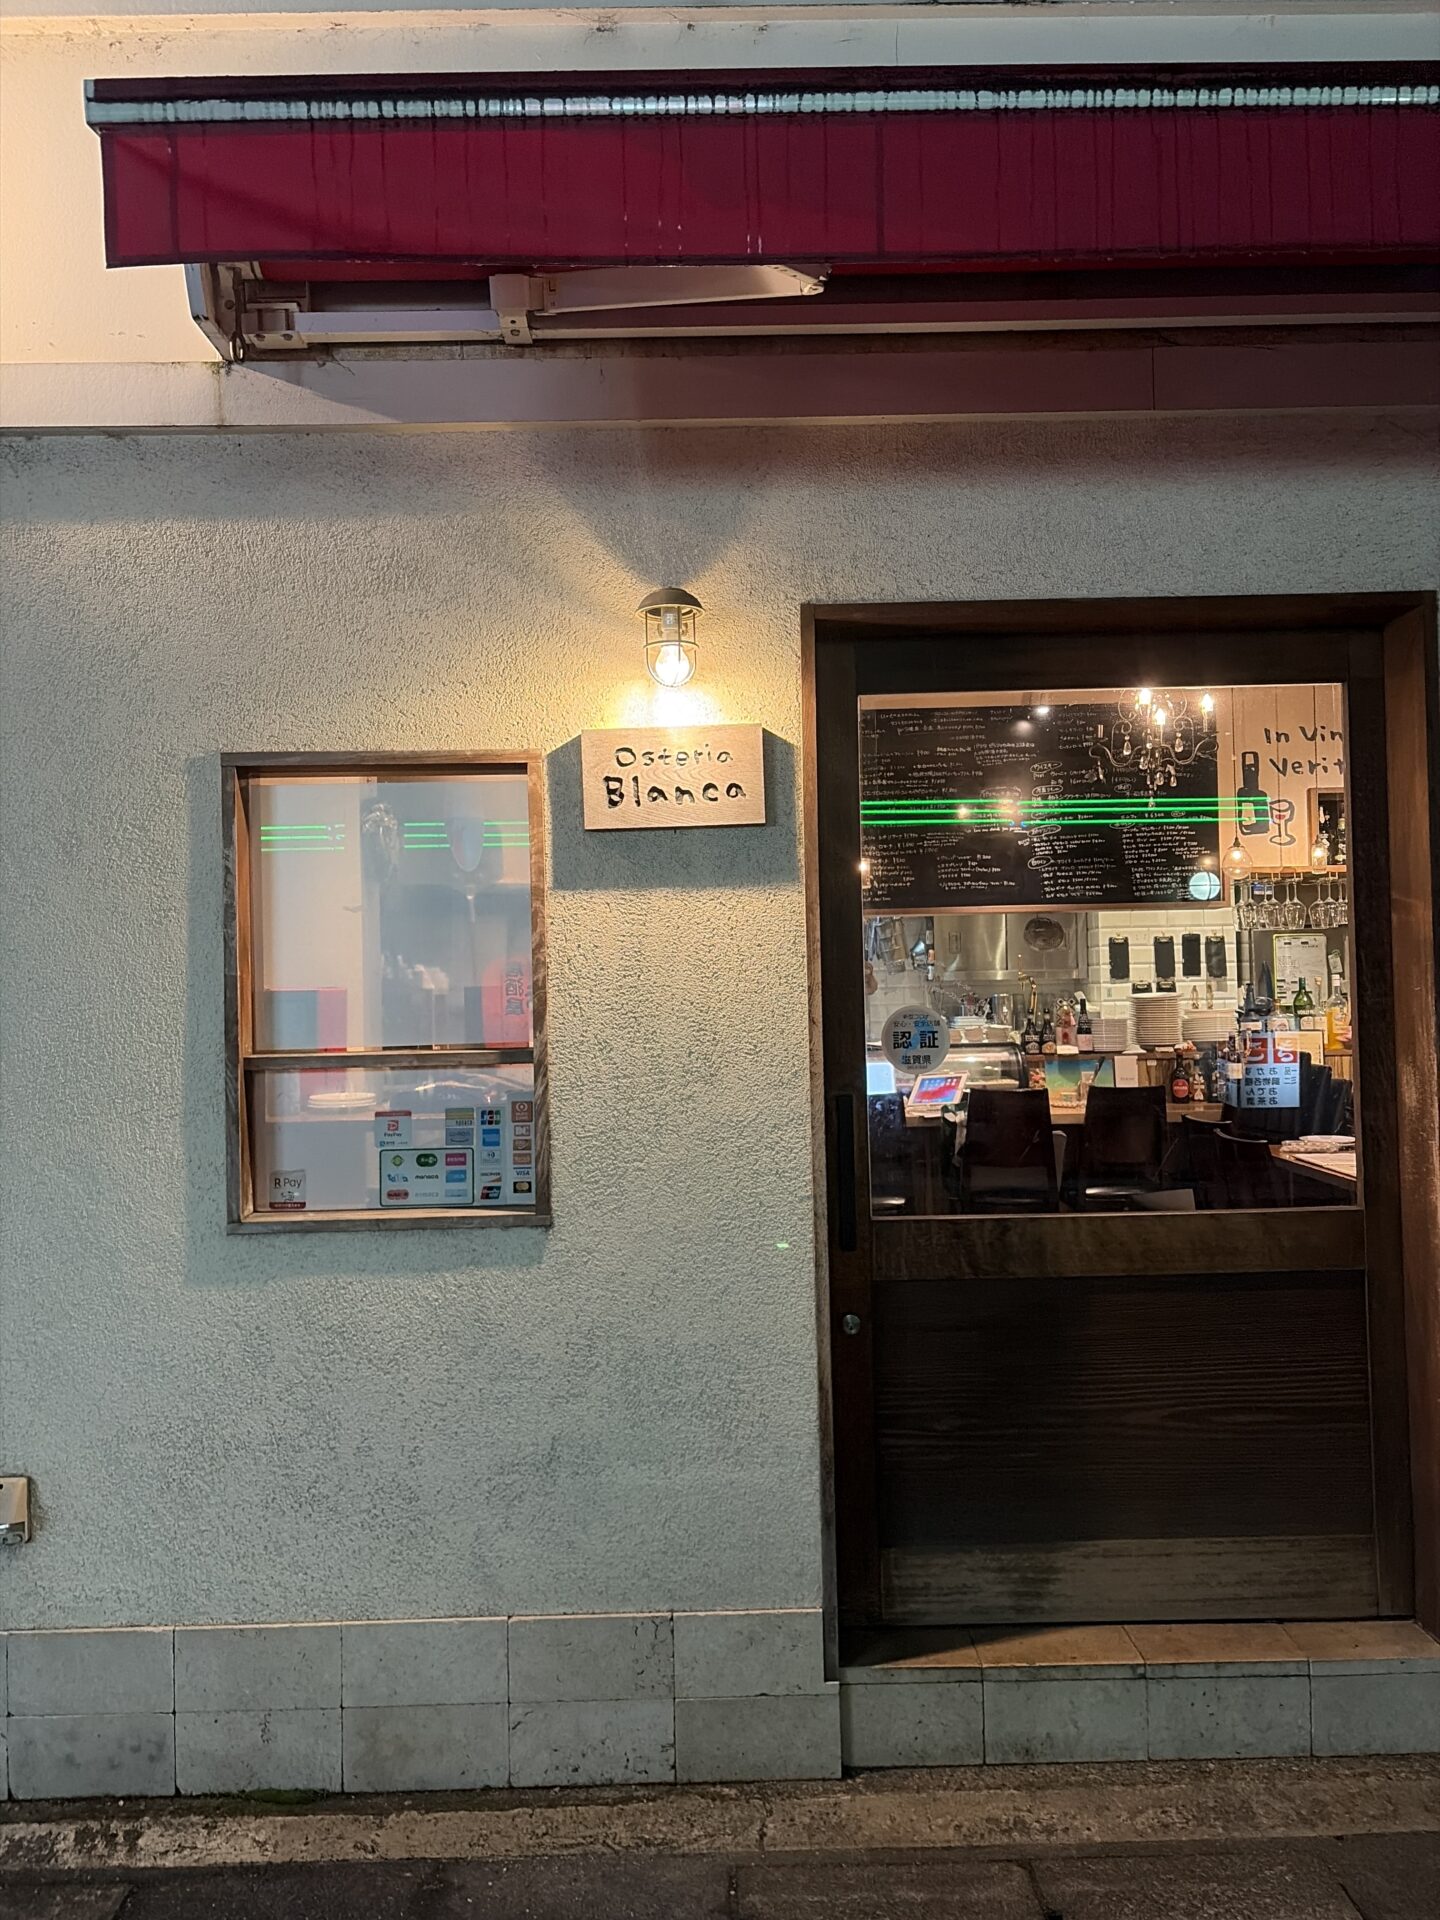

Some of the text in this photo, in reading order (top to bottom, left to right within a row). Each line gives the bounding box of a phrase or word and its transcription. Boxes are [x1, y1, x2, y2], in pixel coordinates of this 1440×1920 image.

[1264, 727, 1290, 745] In
[614, 743, 734, 768] Osteria
[602, 775, 747, 809] Blanca
[892, 1030, 939, 1050] 認証
[901, 1054, 932, 1065] 滋賀県
[283, 1178, 302, 1189] Pay
